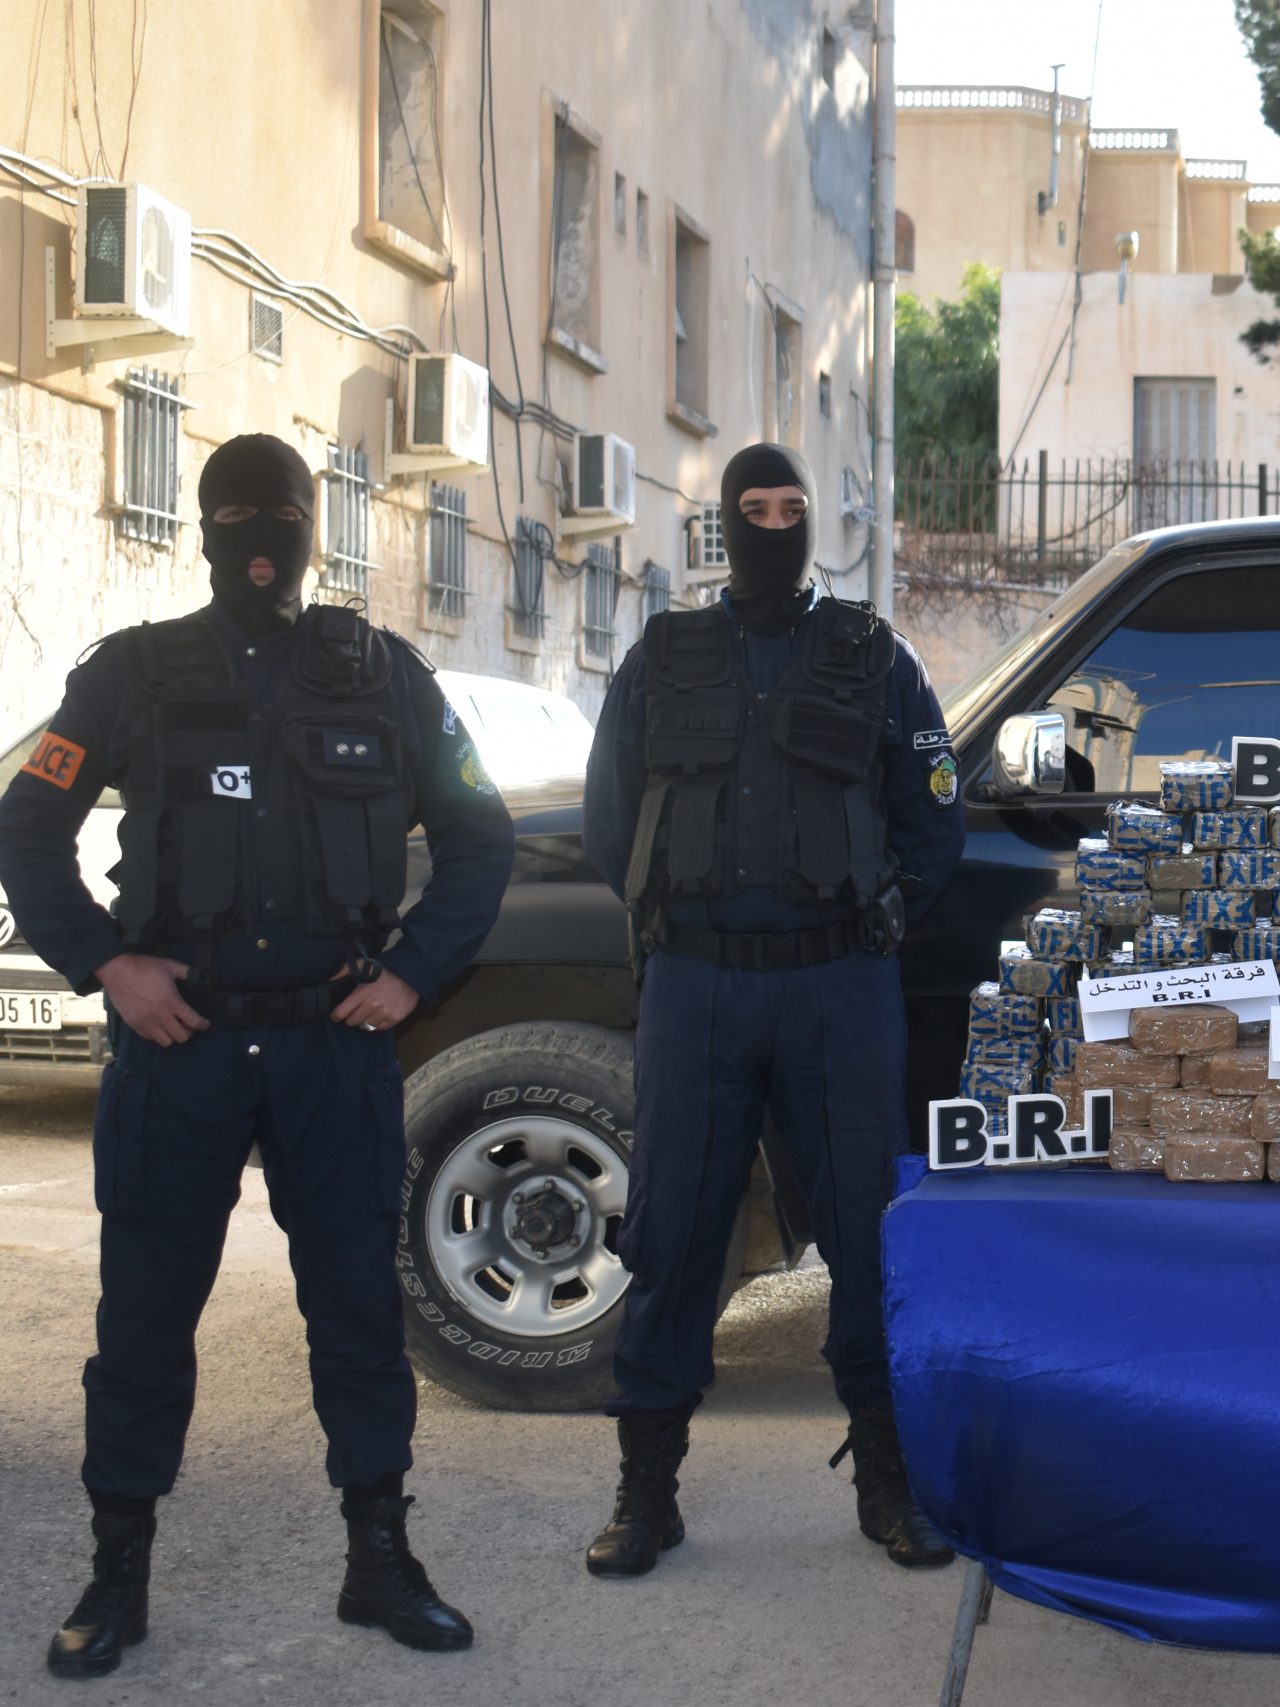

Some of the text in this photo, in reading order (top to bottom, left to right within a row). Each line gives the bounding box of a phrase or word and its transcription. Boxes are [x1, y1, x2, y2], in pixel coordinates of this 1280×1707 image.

[1166, 971, 1217, 988] البحث
[1224, 966, 1266, 982] فرقة
[1089, 981, 1149, 997] التدخل
[1152, 989, 1212, 1003] B.R.I
[30, 998, 53, 1024] 16
[937, 1095, 1111, 1164] B.R.I
